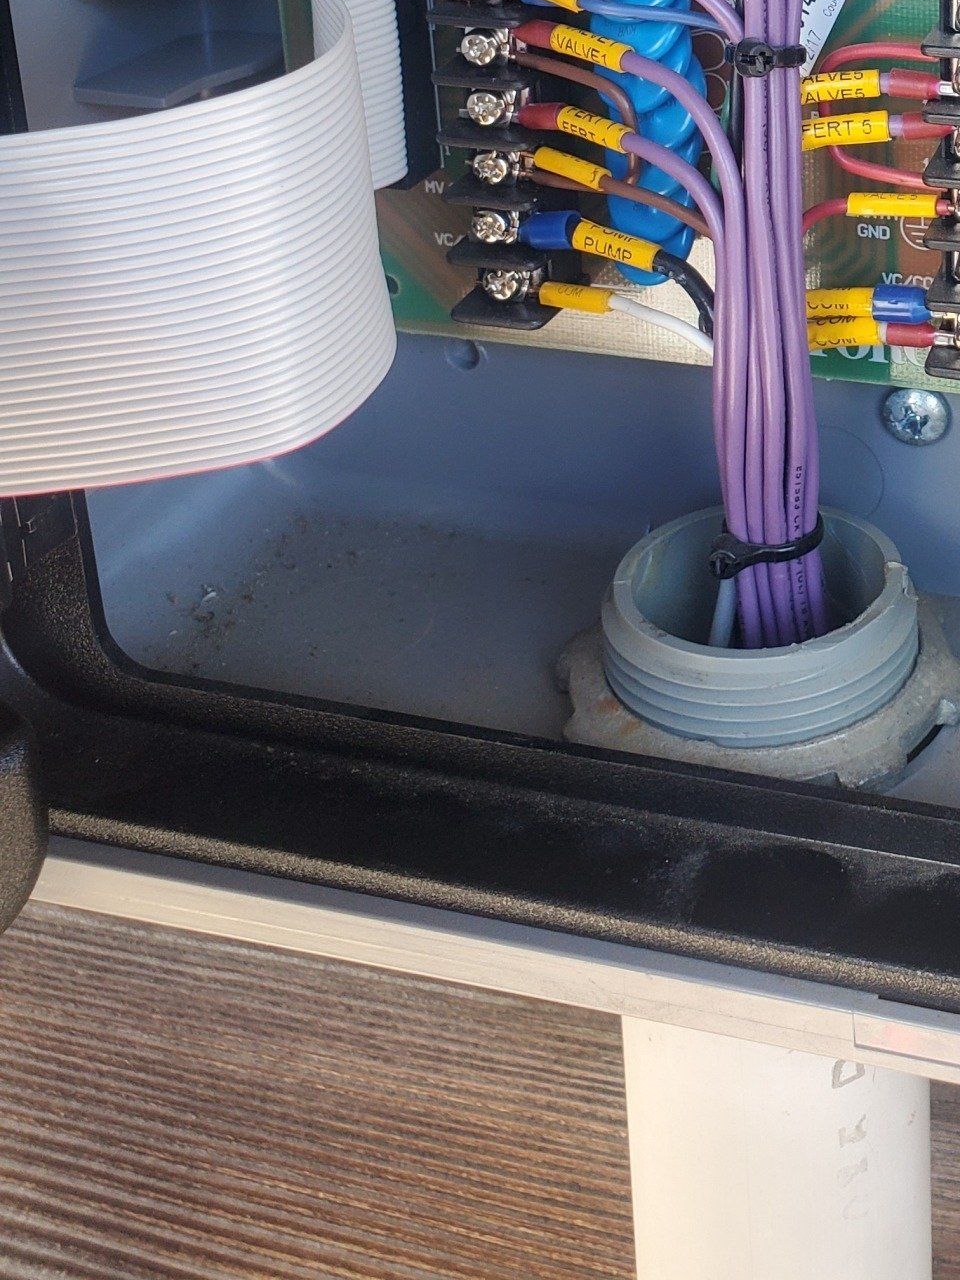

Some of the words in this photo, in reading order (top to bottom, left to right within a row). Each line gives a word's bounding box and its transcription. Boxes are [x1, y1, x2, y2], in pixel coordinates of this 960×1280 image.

[555, 33, 607, 65] VALVE1
[800, 88, 865, 104] ALVE5
[802, 119, 855, 140] FERT
[862, 119, 872, 135] 5
[857, 223, 891, 240] GND
[584, 237, 633, 262] PUMP
[882, 272, 936, 290] VC/CO
